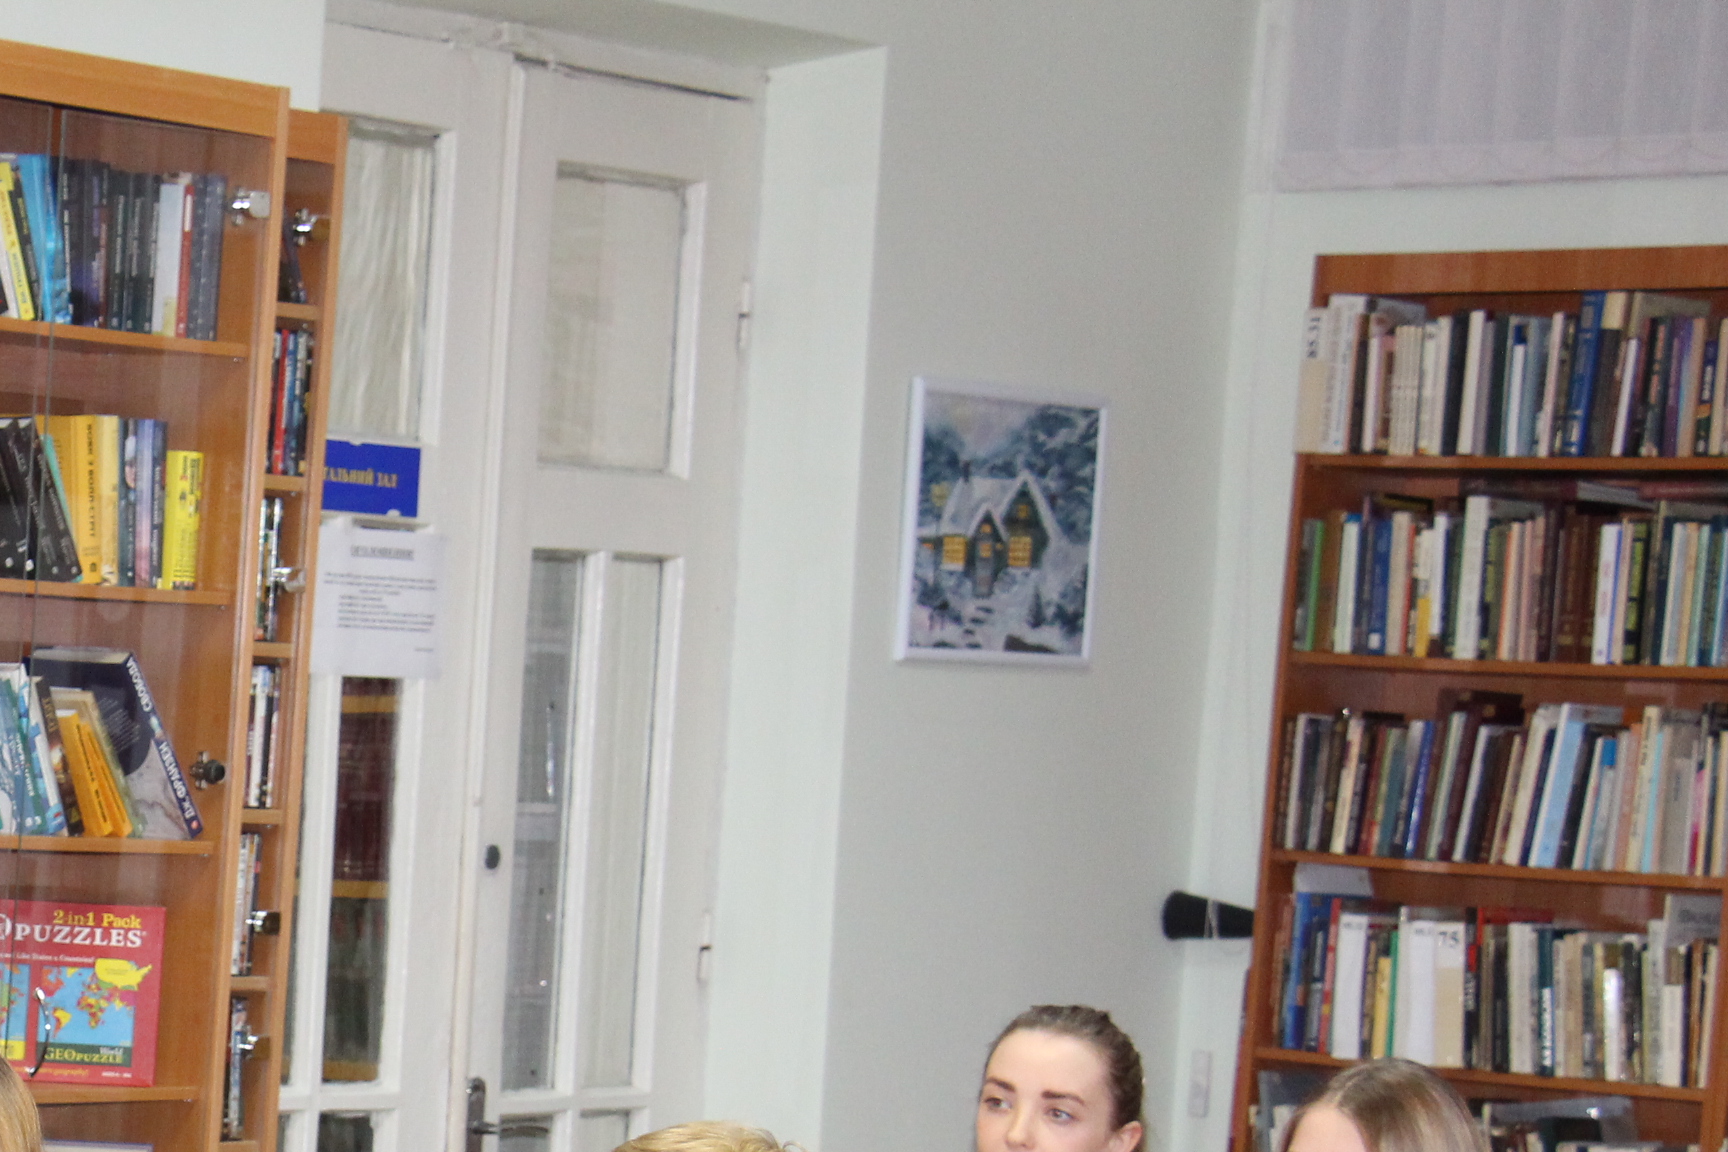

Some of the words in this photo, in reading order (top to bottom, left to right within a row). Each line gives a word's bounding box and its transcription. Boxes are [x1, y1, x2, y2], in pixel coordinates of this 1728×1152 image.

[377, 473, 398, 488] ЗАЛ
[126, 656, 153, 712] СВОБОДА
[159, 741, 186, 797] ФРАНЗЕН
[102, 913, 142, 929] Pack
